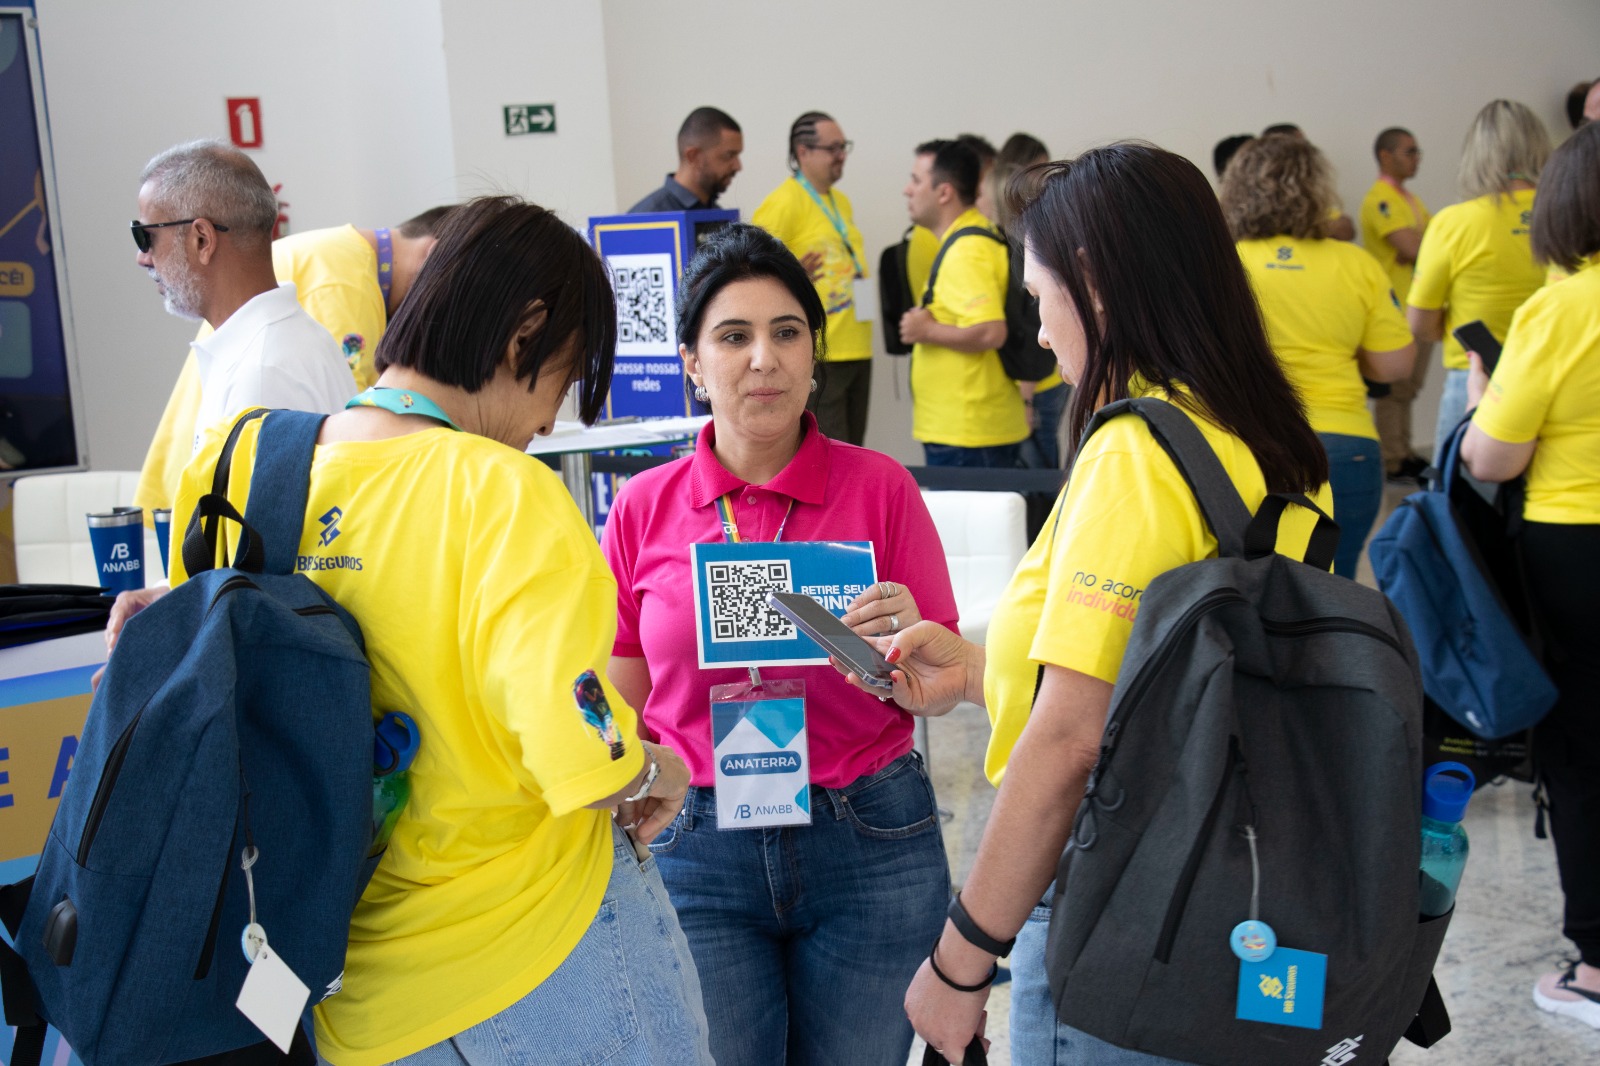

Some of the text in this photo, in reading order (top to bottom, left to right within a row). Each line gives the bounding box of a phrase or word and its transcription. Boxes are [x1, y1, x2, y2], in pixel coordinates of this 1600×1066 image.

[645, 363, 680, 375] nossas
[631, 377, 661, 392] redes
[102, 559, 140, 573] ANABB
[801, 585, 866, 595] RETIRE SEU
[1072, 571, 1143, 602] no acor
[724, 756, 797, 770] ANATERRA
[754, 804, 793, 815] ANABB
